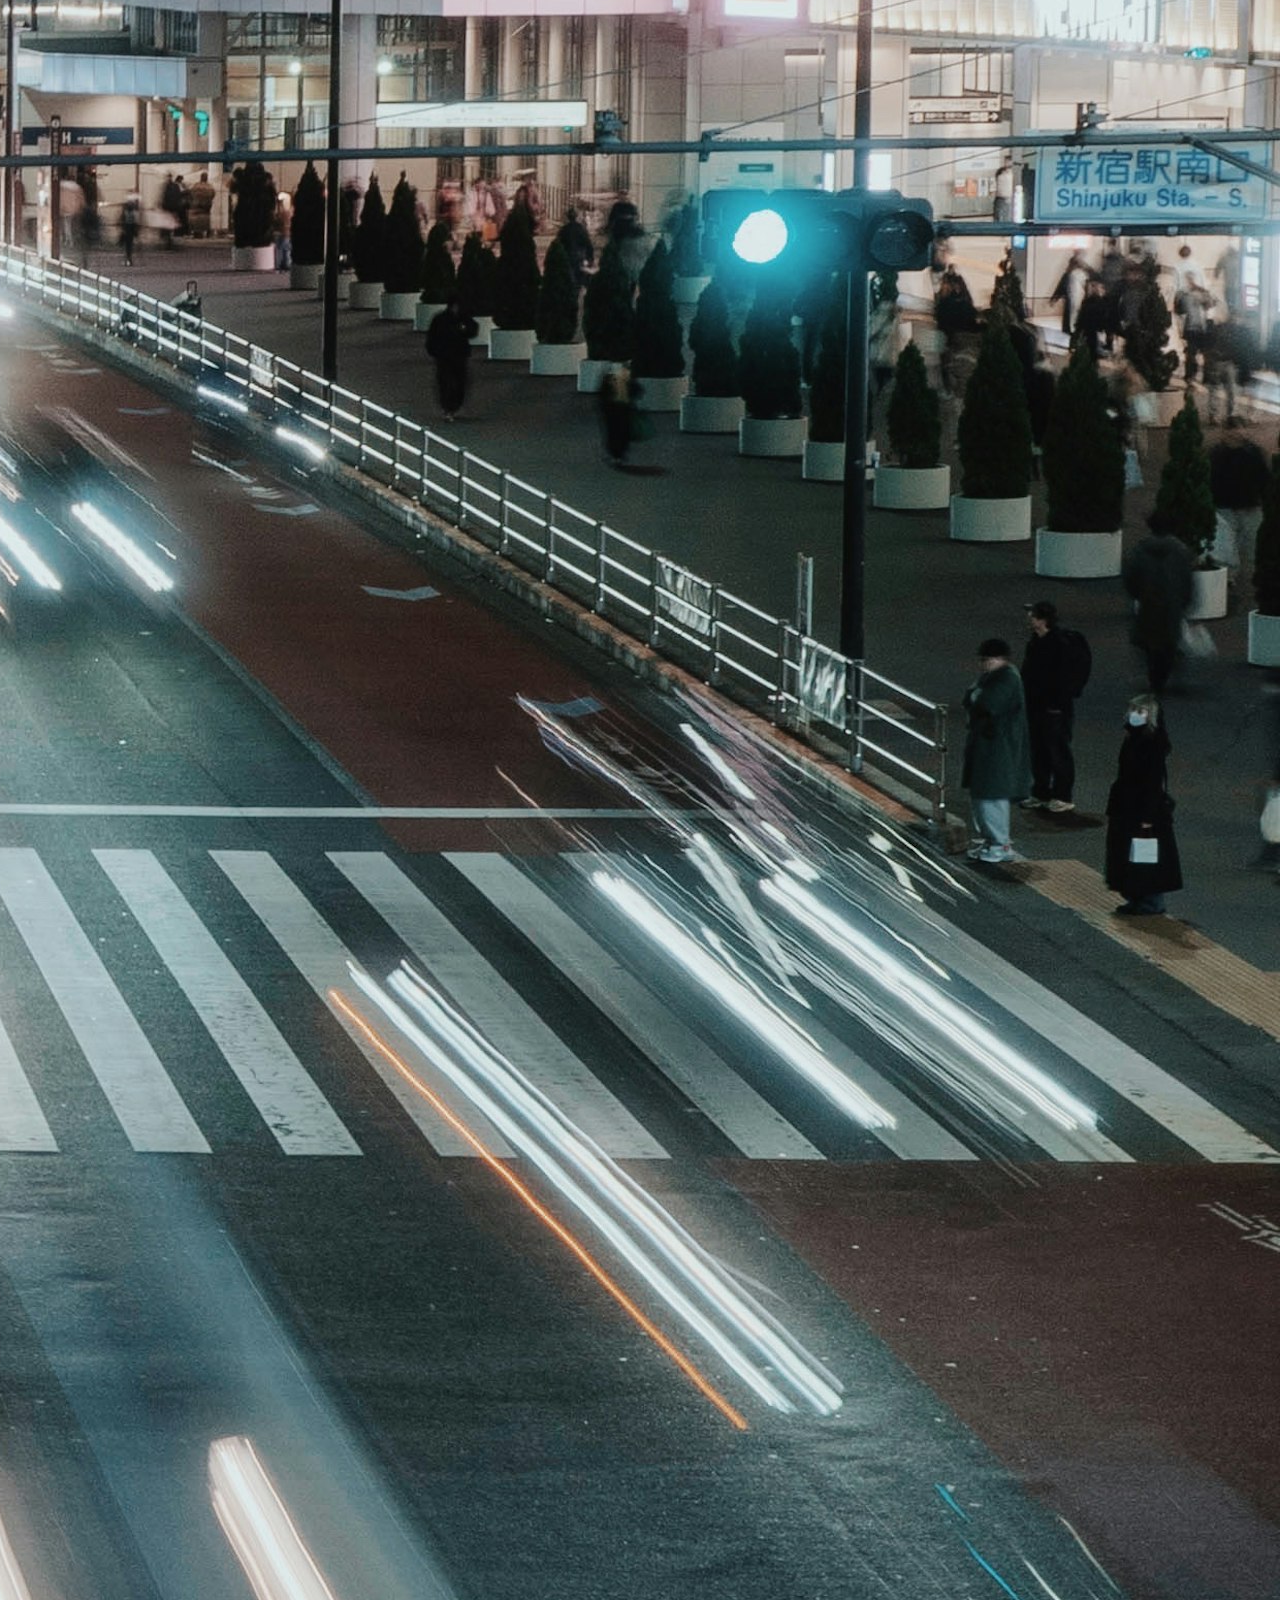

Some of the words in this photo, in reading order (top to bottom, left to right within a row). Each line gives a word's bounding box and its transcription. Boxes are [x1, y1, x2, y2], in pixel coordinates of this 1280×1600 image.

[1054, 148, 1250, 186] 新宿駅南口
[1056, 188, 1147, 211] Shinjuku
[1156, 187, 1195, 207] Sta.
[1227, 187, 1247, 207] S.
